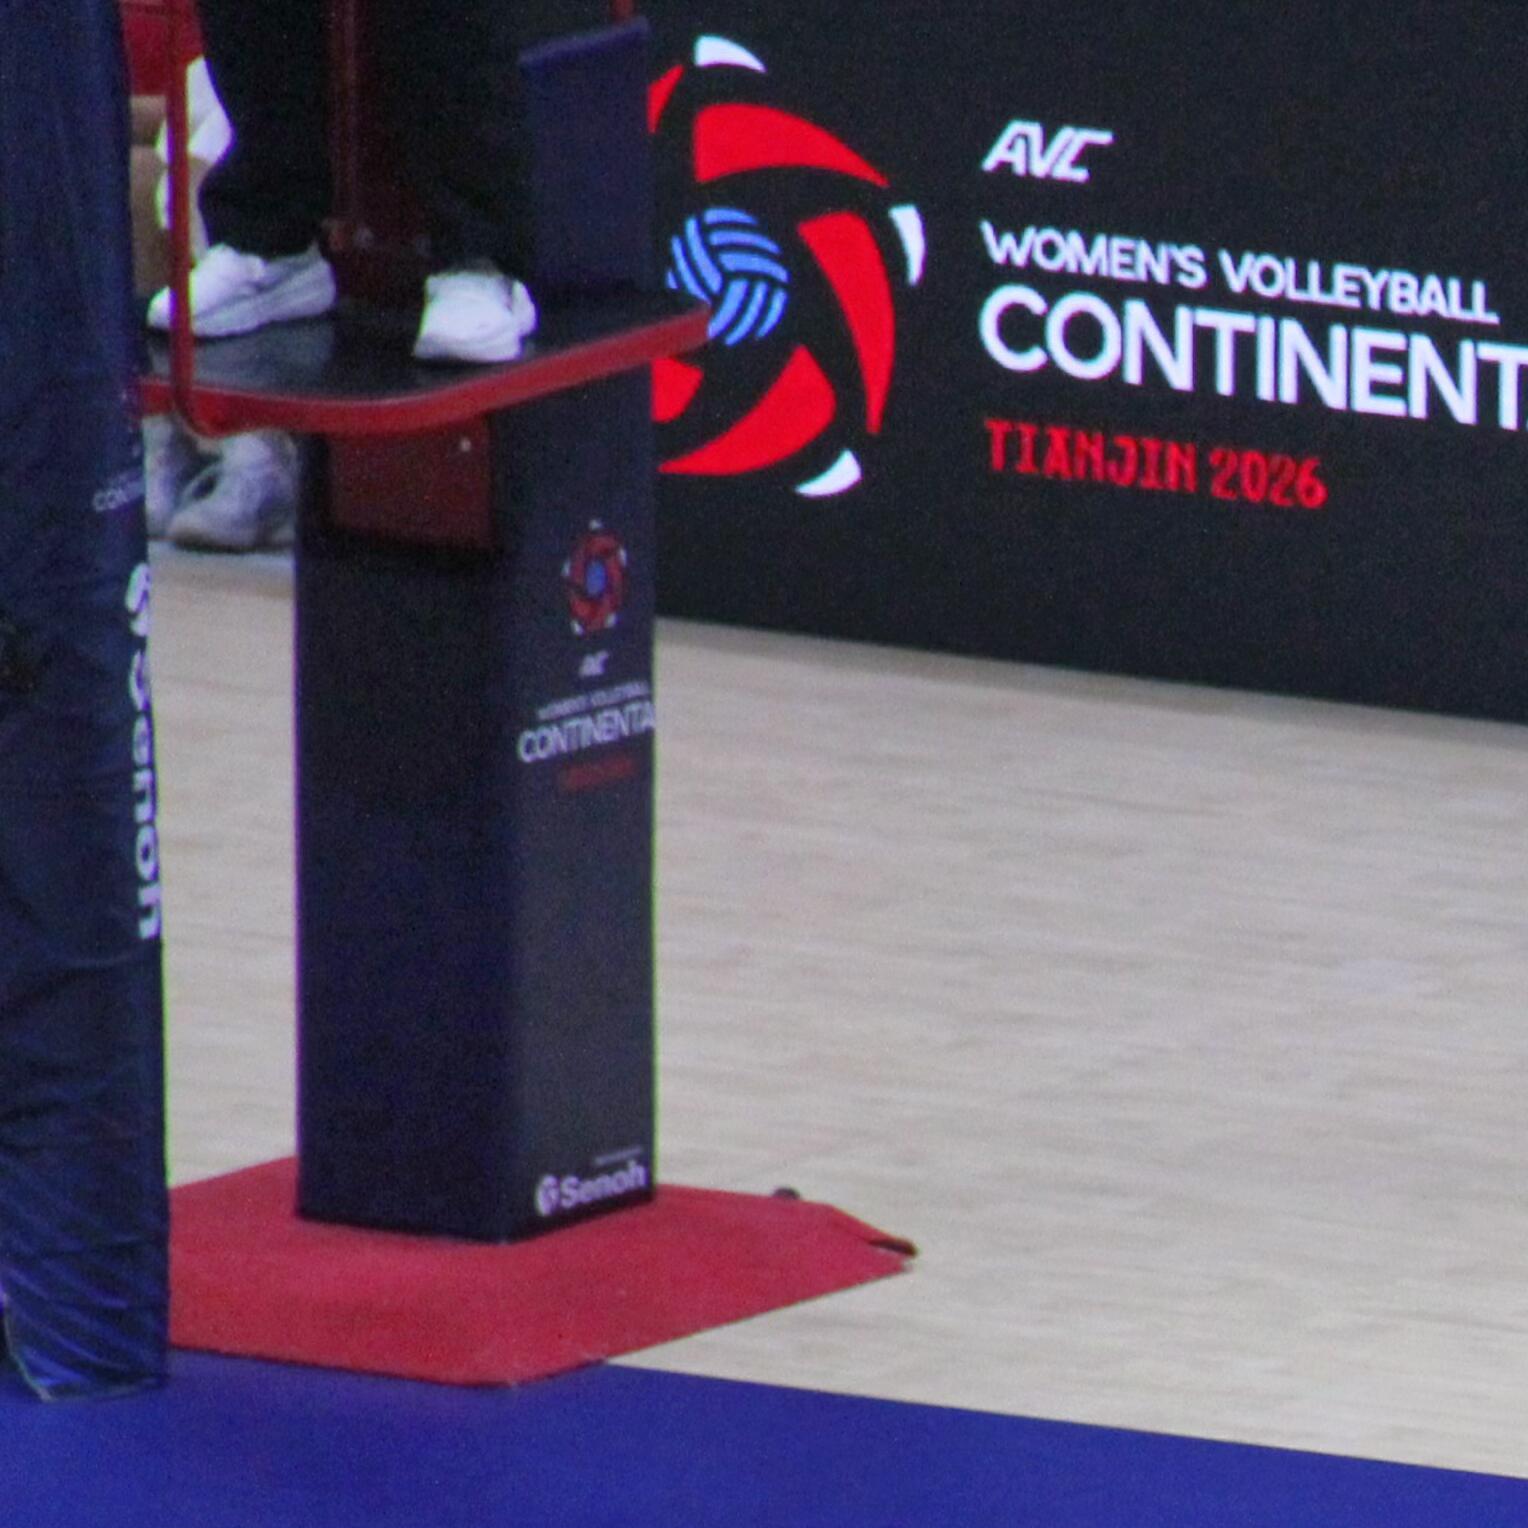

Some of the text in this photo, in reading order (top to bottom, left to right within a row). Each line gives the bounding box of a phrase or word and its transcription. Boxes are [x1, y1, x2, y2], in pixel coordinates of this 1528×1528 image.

[982, 221, 1500, 325] WOMEN'S VOLLEYBALL
[985, 418, 1330, 509] TIANJIN 2026
